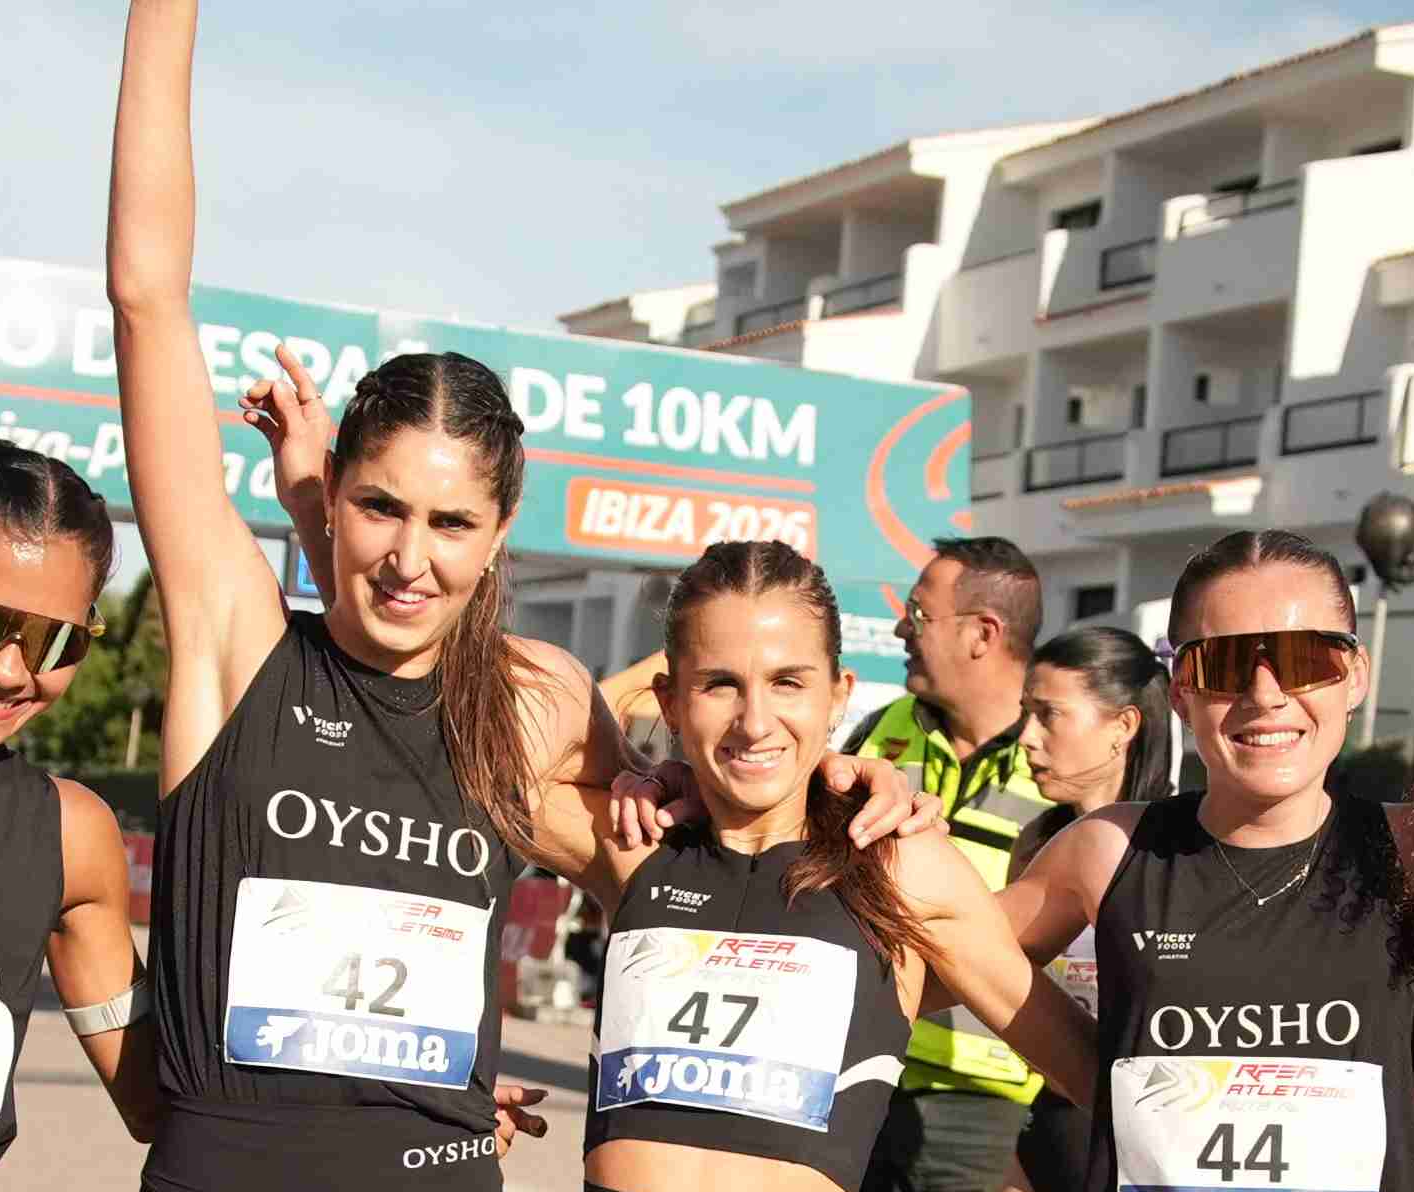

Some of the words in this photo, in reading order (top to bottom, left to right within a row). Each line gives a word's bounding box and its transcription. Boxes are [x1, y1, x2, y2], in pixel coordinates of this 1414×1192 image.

[198, 322, 428, 412] ESPA
[509, 367, 606, 440] DE
[622, 383, 816, 467] 10KM
[578, 487, 696, 545] IBIZA
[312, 716, 354, 732] VICKY
[266, 789, 489, 877] OYSHO
[705, 954, 812, 976] ATLETISM
[1155, 932, 1196, 943] VICKY
[322, 951, 409, 1017] 42
[666, 990, 760, 1048] 47
[1149, 1000, 1361, 1050] OYSHO
[402, 1135, 497, 1169] OYSHO
[1196, 1122, 1290, 1184] 44
